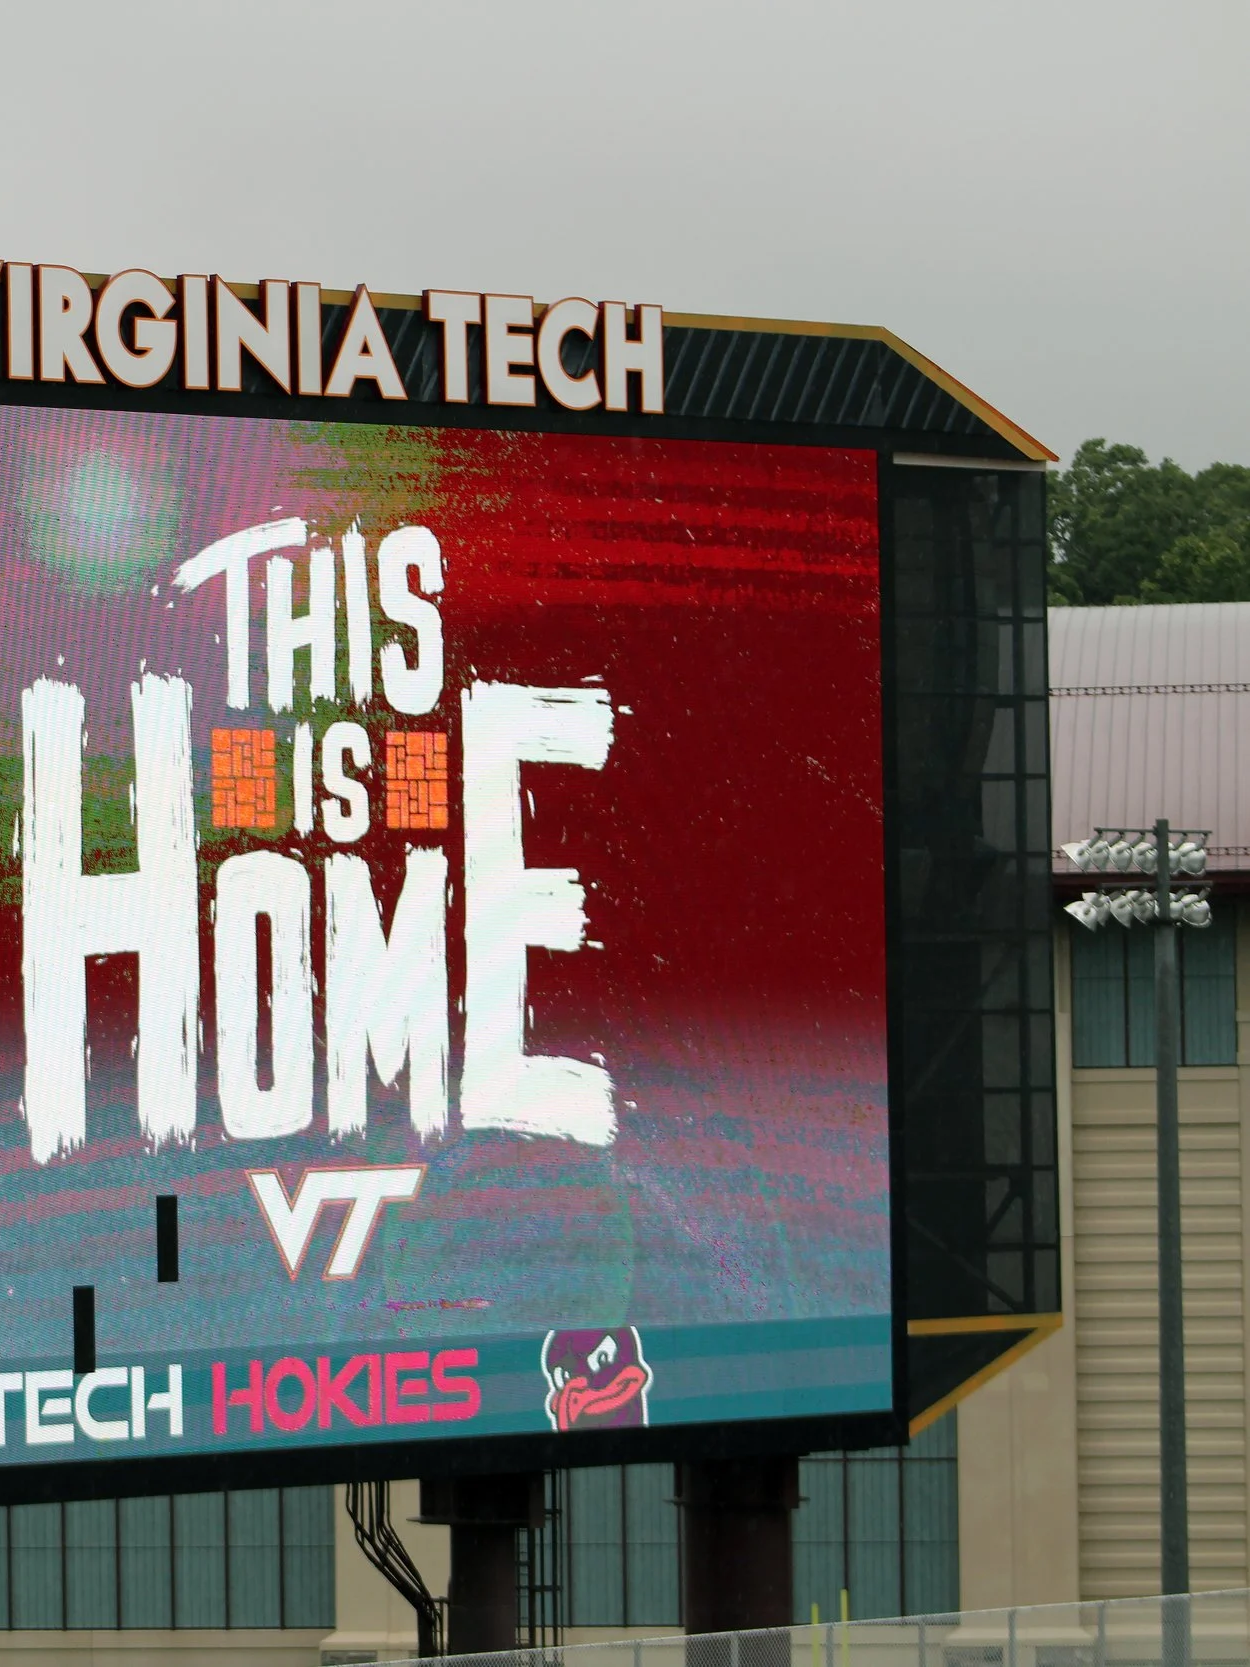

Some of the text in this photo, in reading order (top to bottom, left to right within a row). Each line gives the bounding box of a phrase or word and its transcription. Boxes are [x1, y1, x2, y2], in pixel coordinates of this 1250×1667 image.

[423, 288, 664, 416] TECH
[172, 515, 444, 715] THIS
[293, 721, 371, 843] IS
[20, 672, 617, 1165] HOME
[244, 1164, 427, 1282] VT
[211, 1348, 481, 1435] HOKIES
